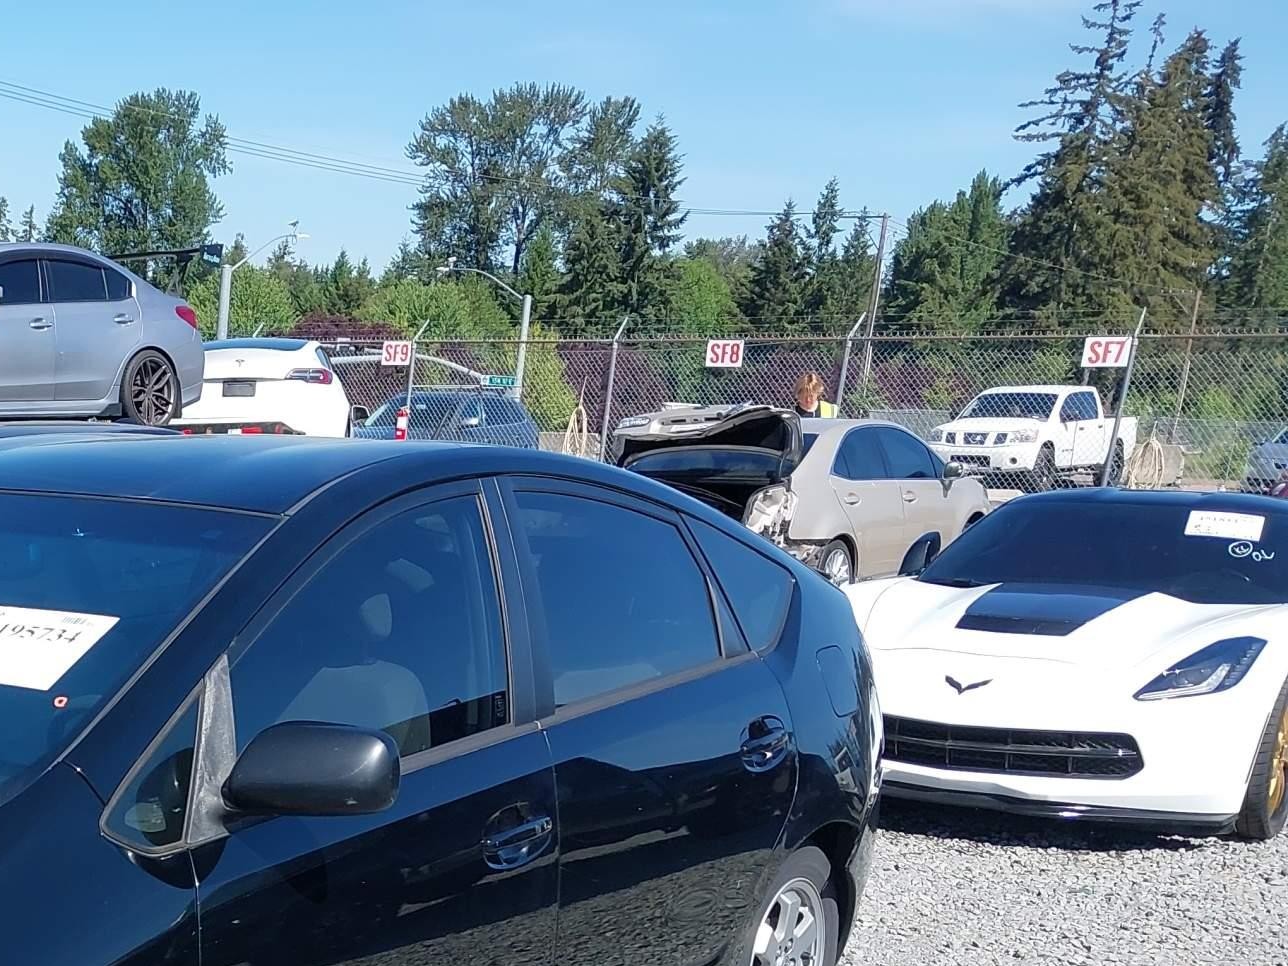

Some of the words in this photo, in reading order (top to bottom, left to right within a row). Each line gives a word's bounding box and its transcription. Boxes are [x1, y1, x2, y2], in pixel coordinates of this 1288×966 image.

[385, 344, 409, 362] SF9
[710, 343, 740, 363] SF8
[1088, 340, 1126, 363] SF7
